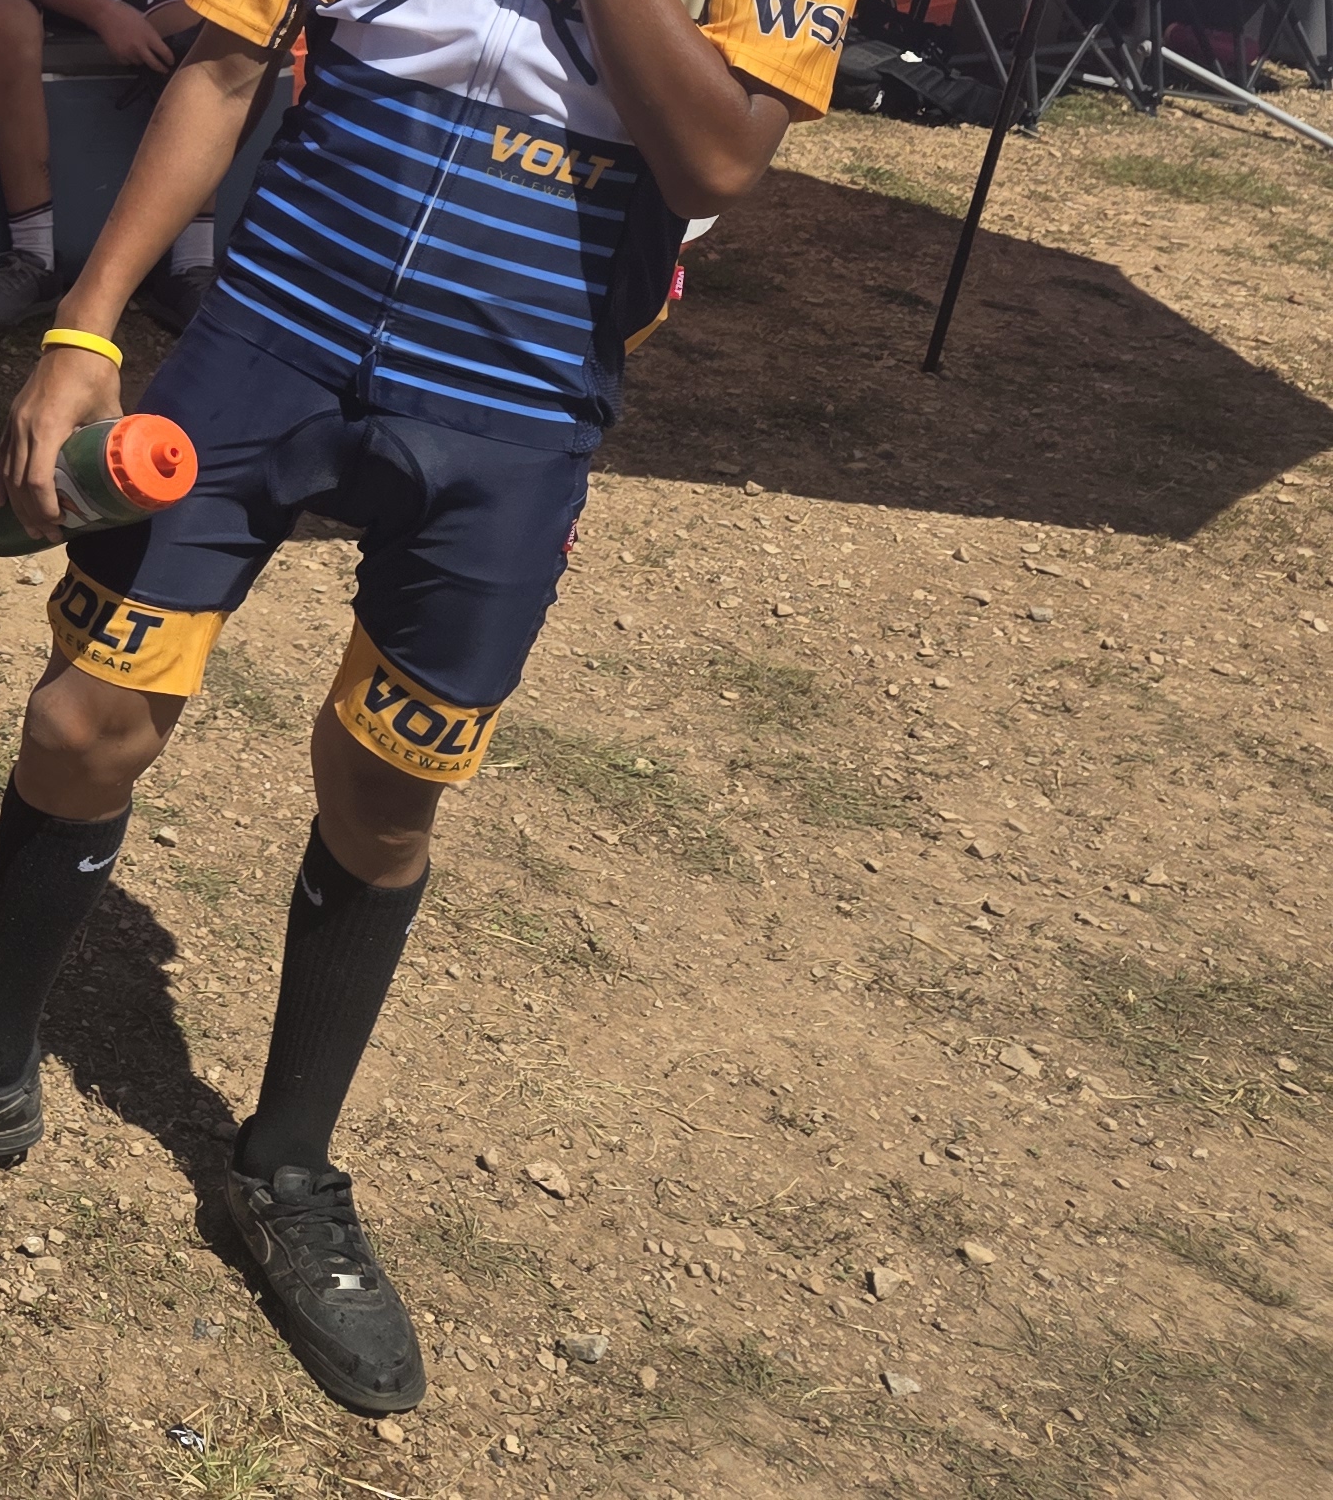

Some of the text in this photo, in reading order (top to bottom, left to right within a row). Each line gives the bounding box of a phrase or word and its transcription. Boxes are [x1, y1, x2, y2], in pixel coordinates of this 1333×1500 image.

[491, 125, 616, 189] VOLT
[364, 664, 495, 755] VOLT
[355, 712, 472, 772] CYCLEWEAR
